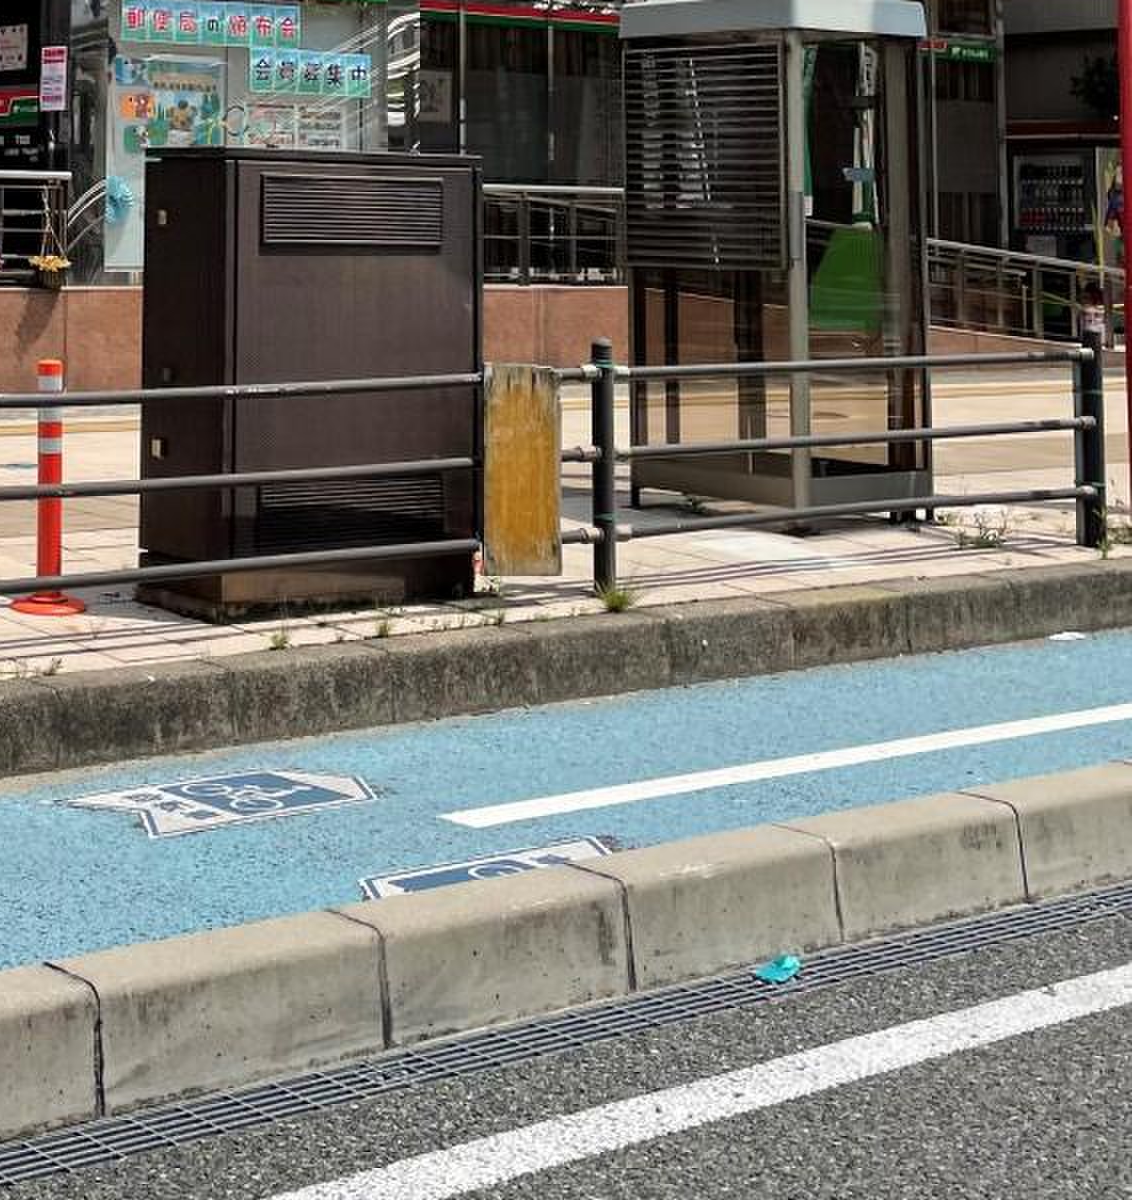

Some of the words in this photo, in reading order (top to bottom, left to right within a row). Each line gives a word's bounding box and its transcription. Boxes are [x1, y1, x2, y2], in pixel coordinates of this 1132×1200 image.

[126, 7, 295, 40] 郵便局の頒布会
[255, 57, 370, 87] 会員募集中
